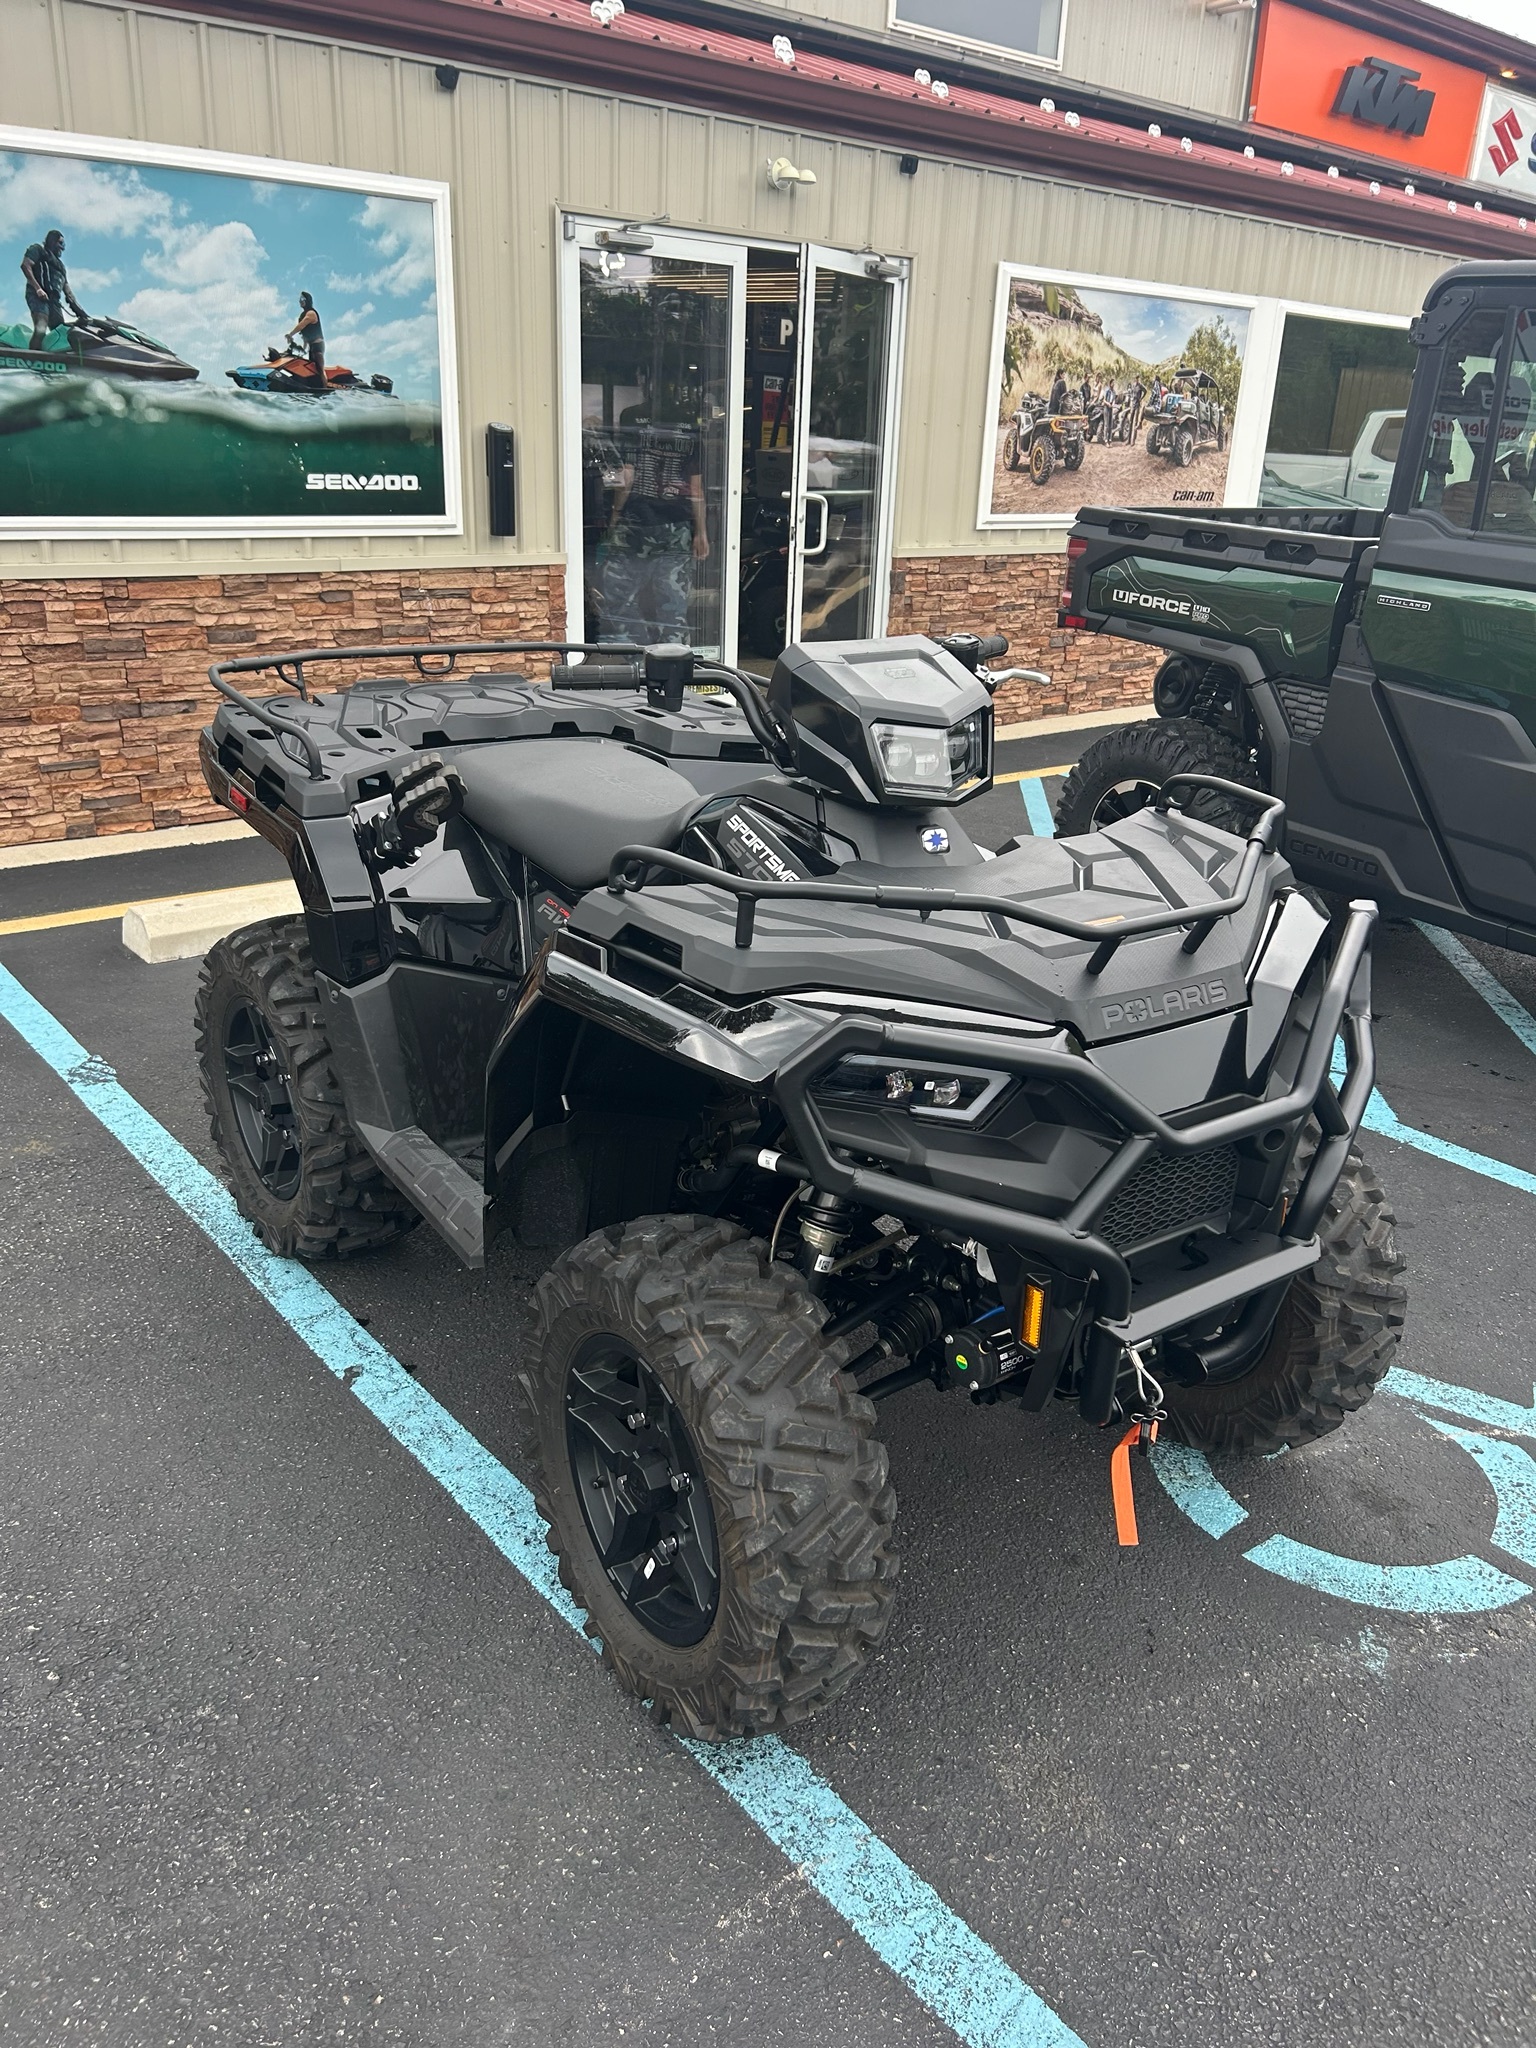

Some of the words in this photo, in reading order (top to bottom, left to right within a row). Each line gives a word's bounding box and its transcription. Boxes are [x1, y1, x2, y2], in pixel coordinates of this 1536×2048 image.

[1332, 56, 1436, 138] KTM
[1173, 490, 1214, 502] can-am
[1379, 597, 1428, 609] HIGHLAND
[1290, 840, 1379, 876] CFMOTO
[1101, 979, 1228, 1030] POLARIS
[1000, 1355, 1024, 1370] 2500
